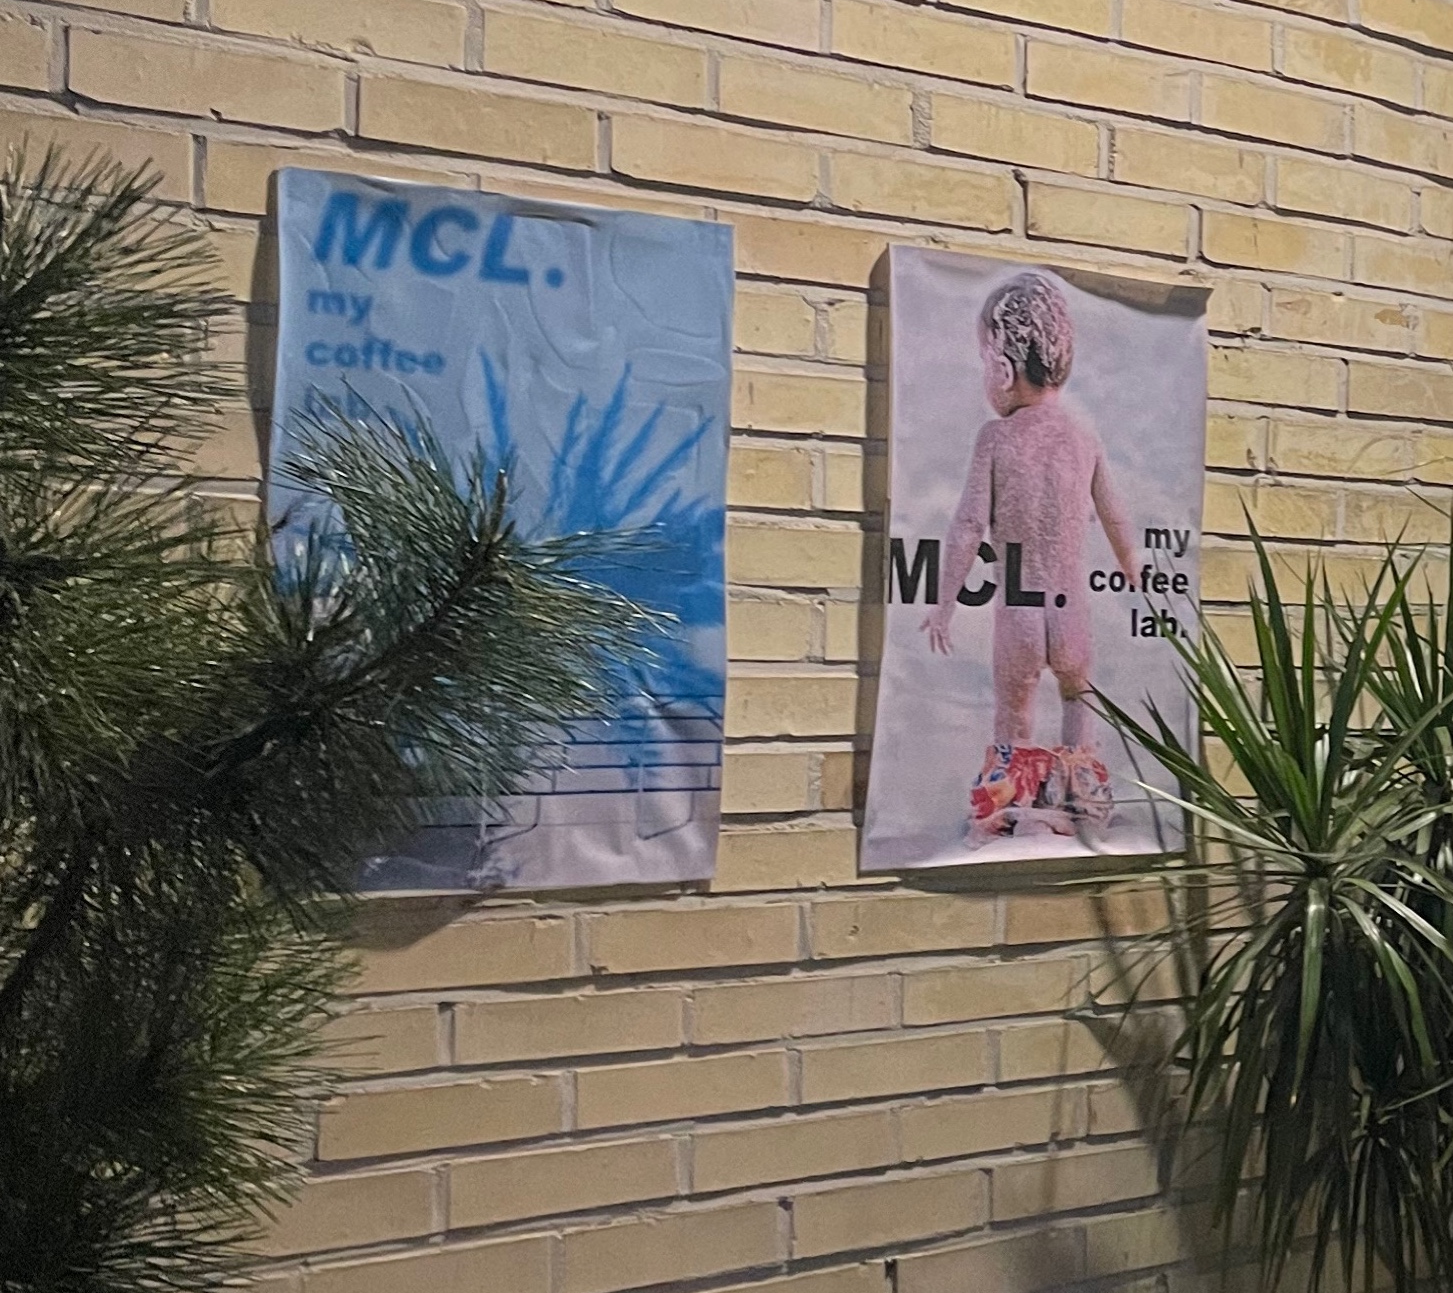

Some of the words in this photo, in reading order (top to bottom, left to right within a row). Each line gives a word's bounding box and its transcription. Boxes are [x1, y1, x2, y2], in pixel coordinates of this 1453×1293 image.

[313, 191, 565, 289] MCL.
[306, 288, 372, 323] my
[305, 335, 446, 375] coffee
[1145, 528, 1190, 558] my
[1089, 564, 1189, 595] cofee
